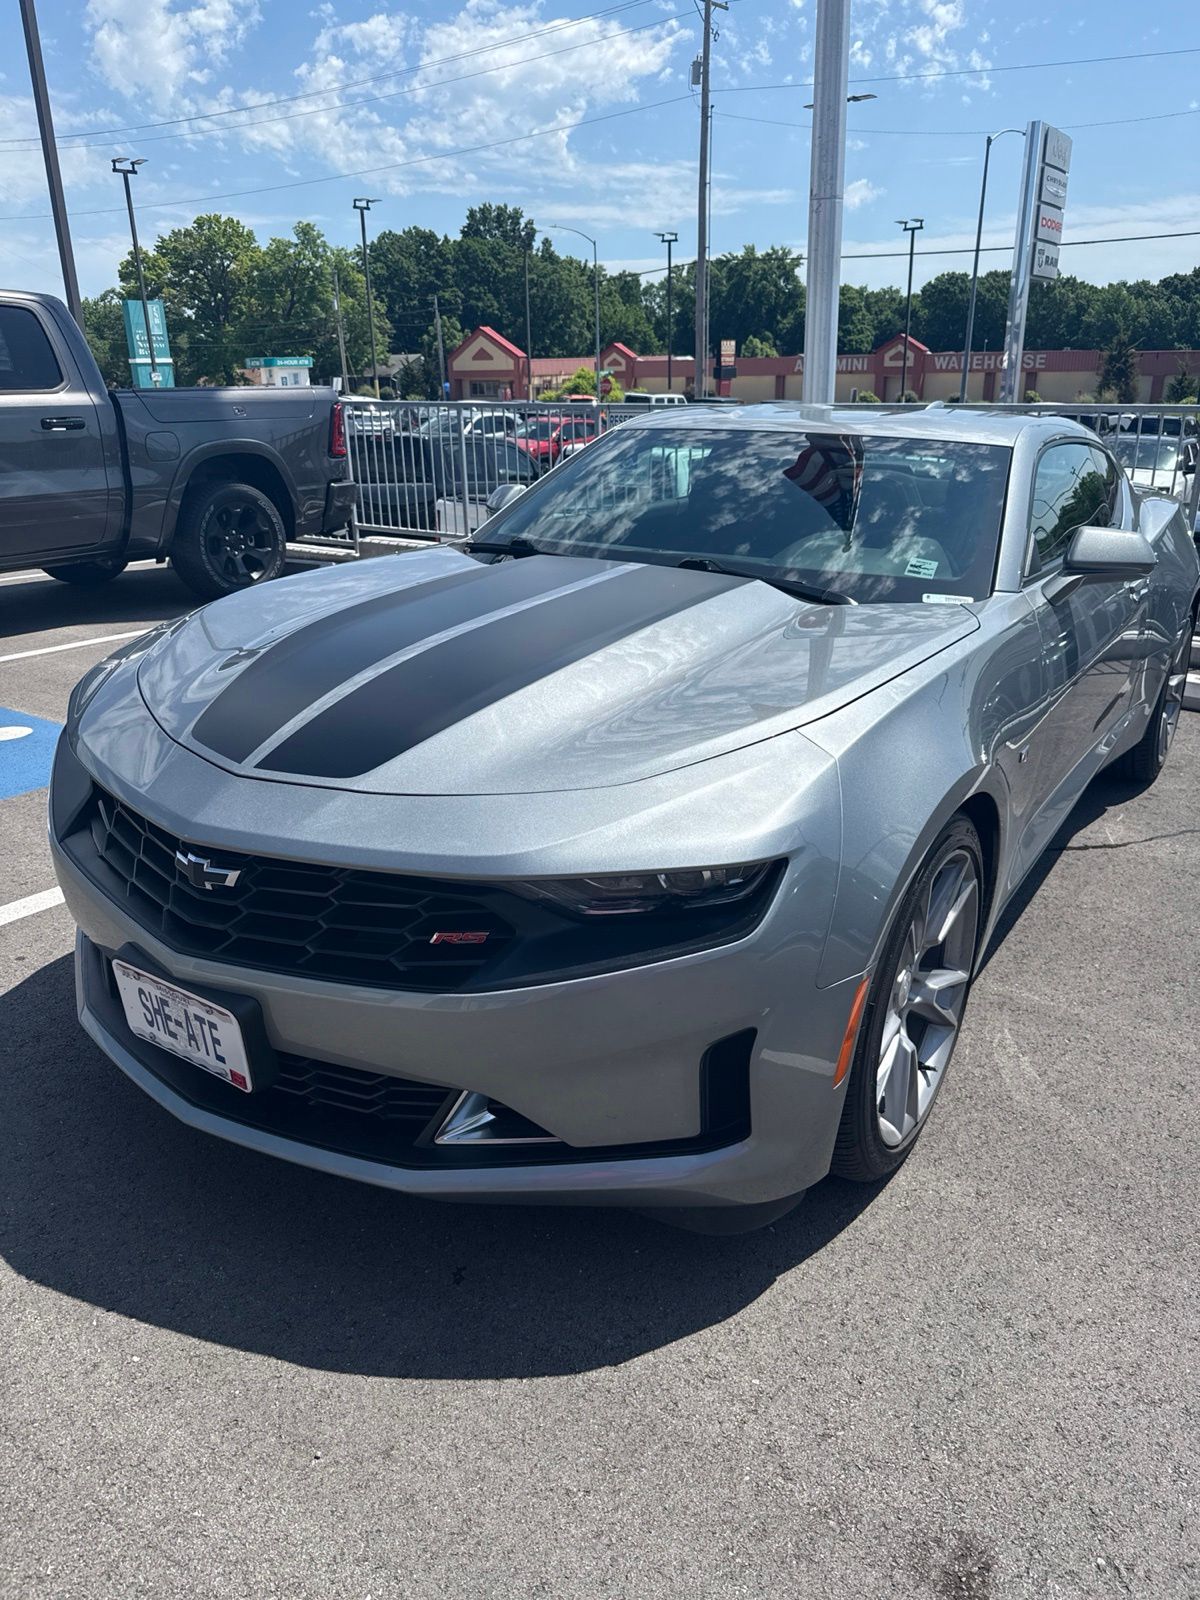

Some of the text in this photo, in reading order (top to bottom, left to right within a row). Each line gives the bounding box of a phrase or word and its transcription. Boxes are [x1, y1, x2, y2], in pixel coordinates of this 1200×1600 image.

[1041, 216, 1062, 233] DODGE
[1044, 255, 1059, 268] RAM
[836, 357, 868, 371] MINI
[934, 354, 1047, 370] WAEHOSE
[429, 932, 490, 944] RS
[156, 985, 191, 1005] MISSOURI
[138, 987, 226, 1065] SHE-ATE
